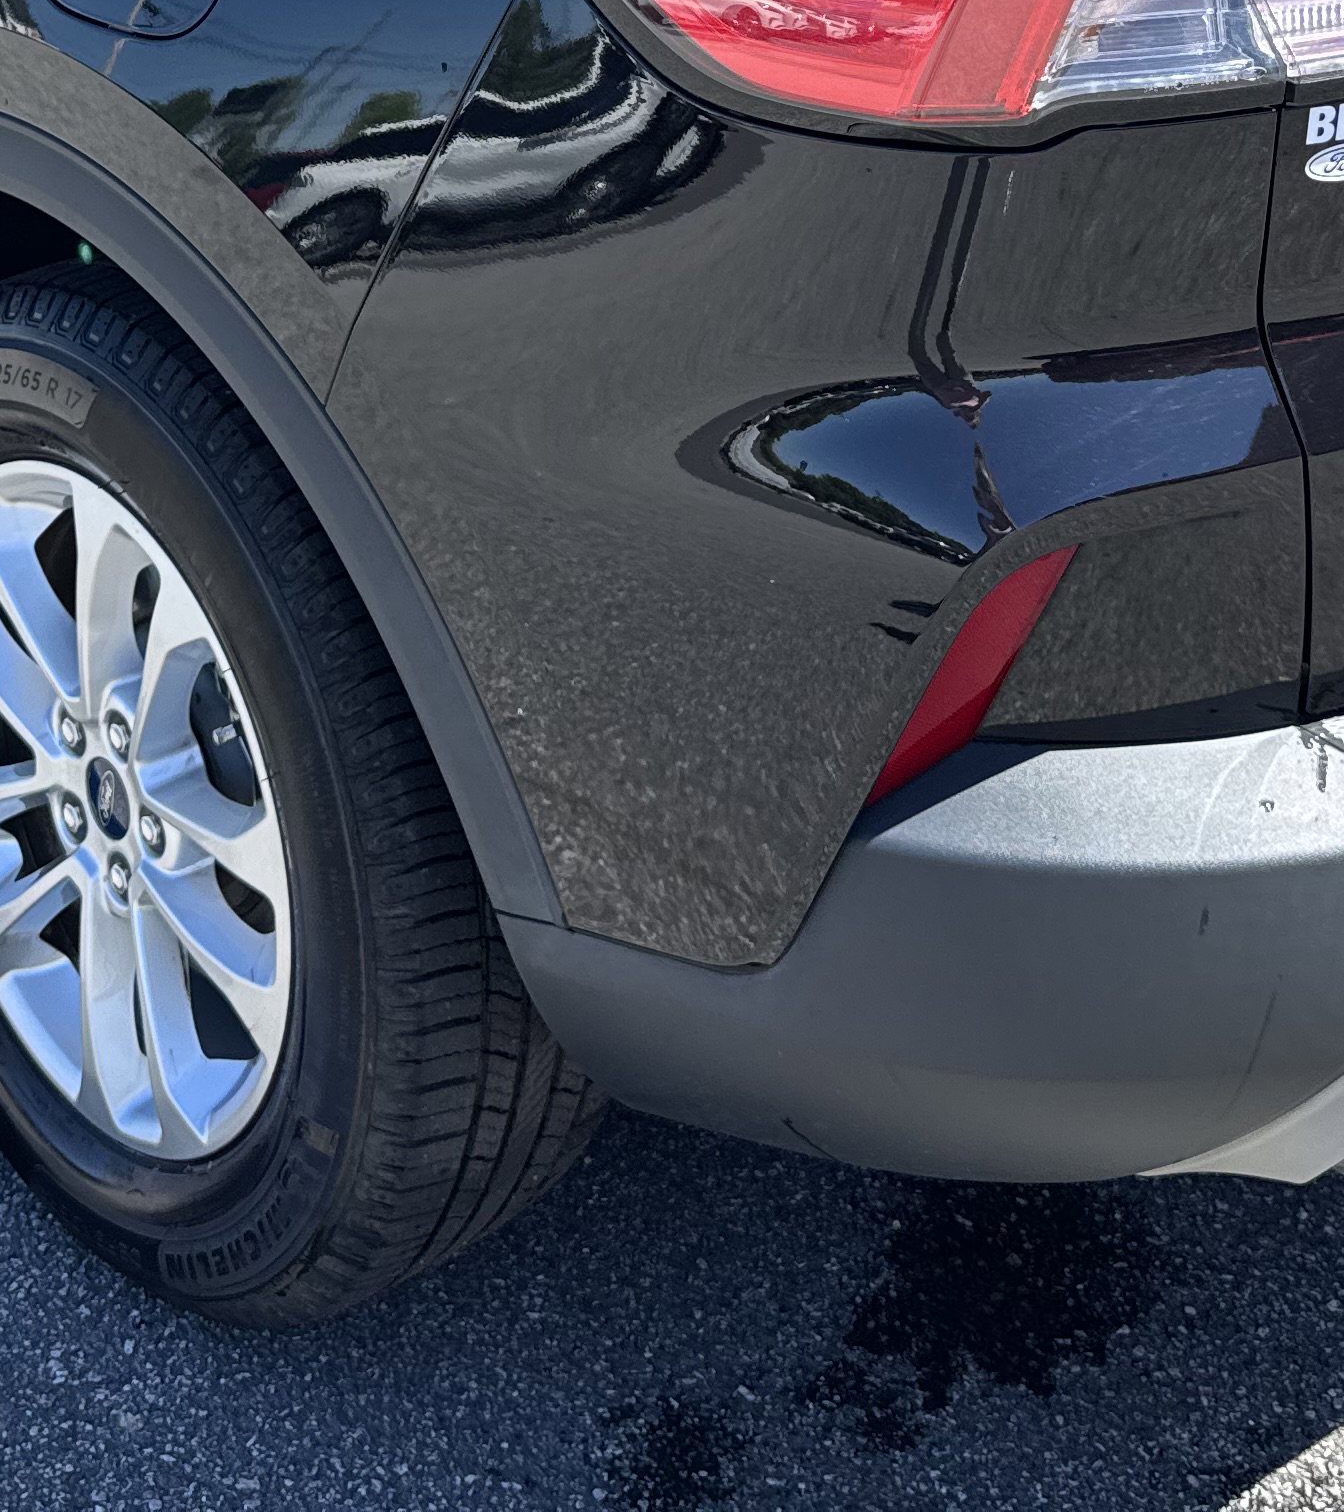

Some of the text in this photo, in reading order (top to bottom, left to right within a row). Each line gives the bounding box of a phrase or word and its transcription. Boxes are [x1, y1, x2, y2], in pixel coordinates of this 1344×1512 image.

[45, 377, 59, 400] R
[64, 387, 84, 409] 17
[164, 1192, 295, 1281] MICHELIN
